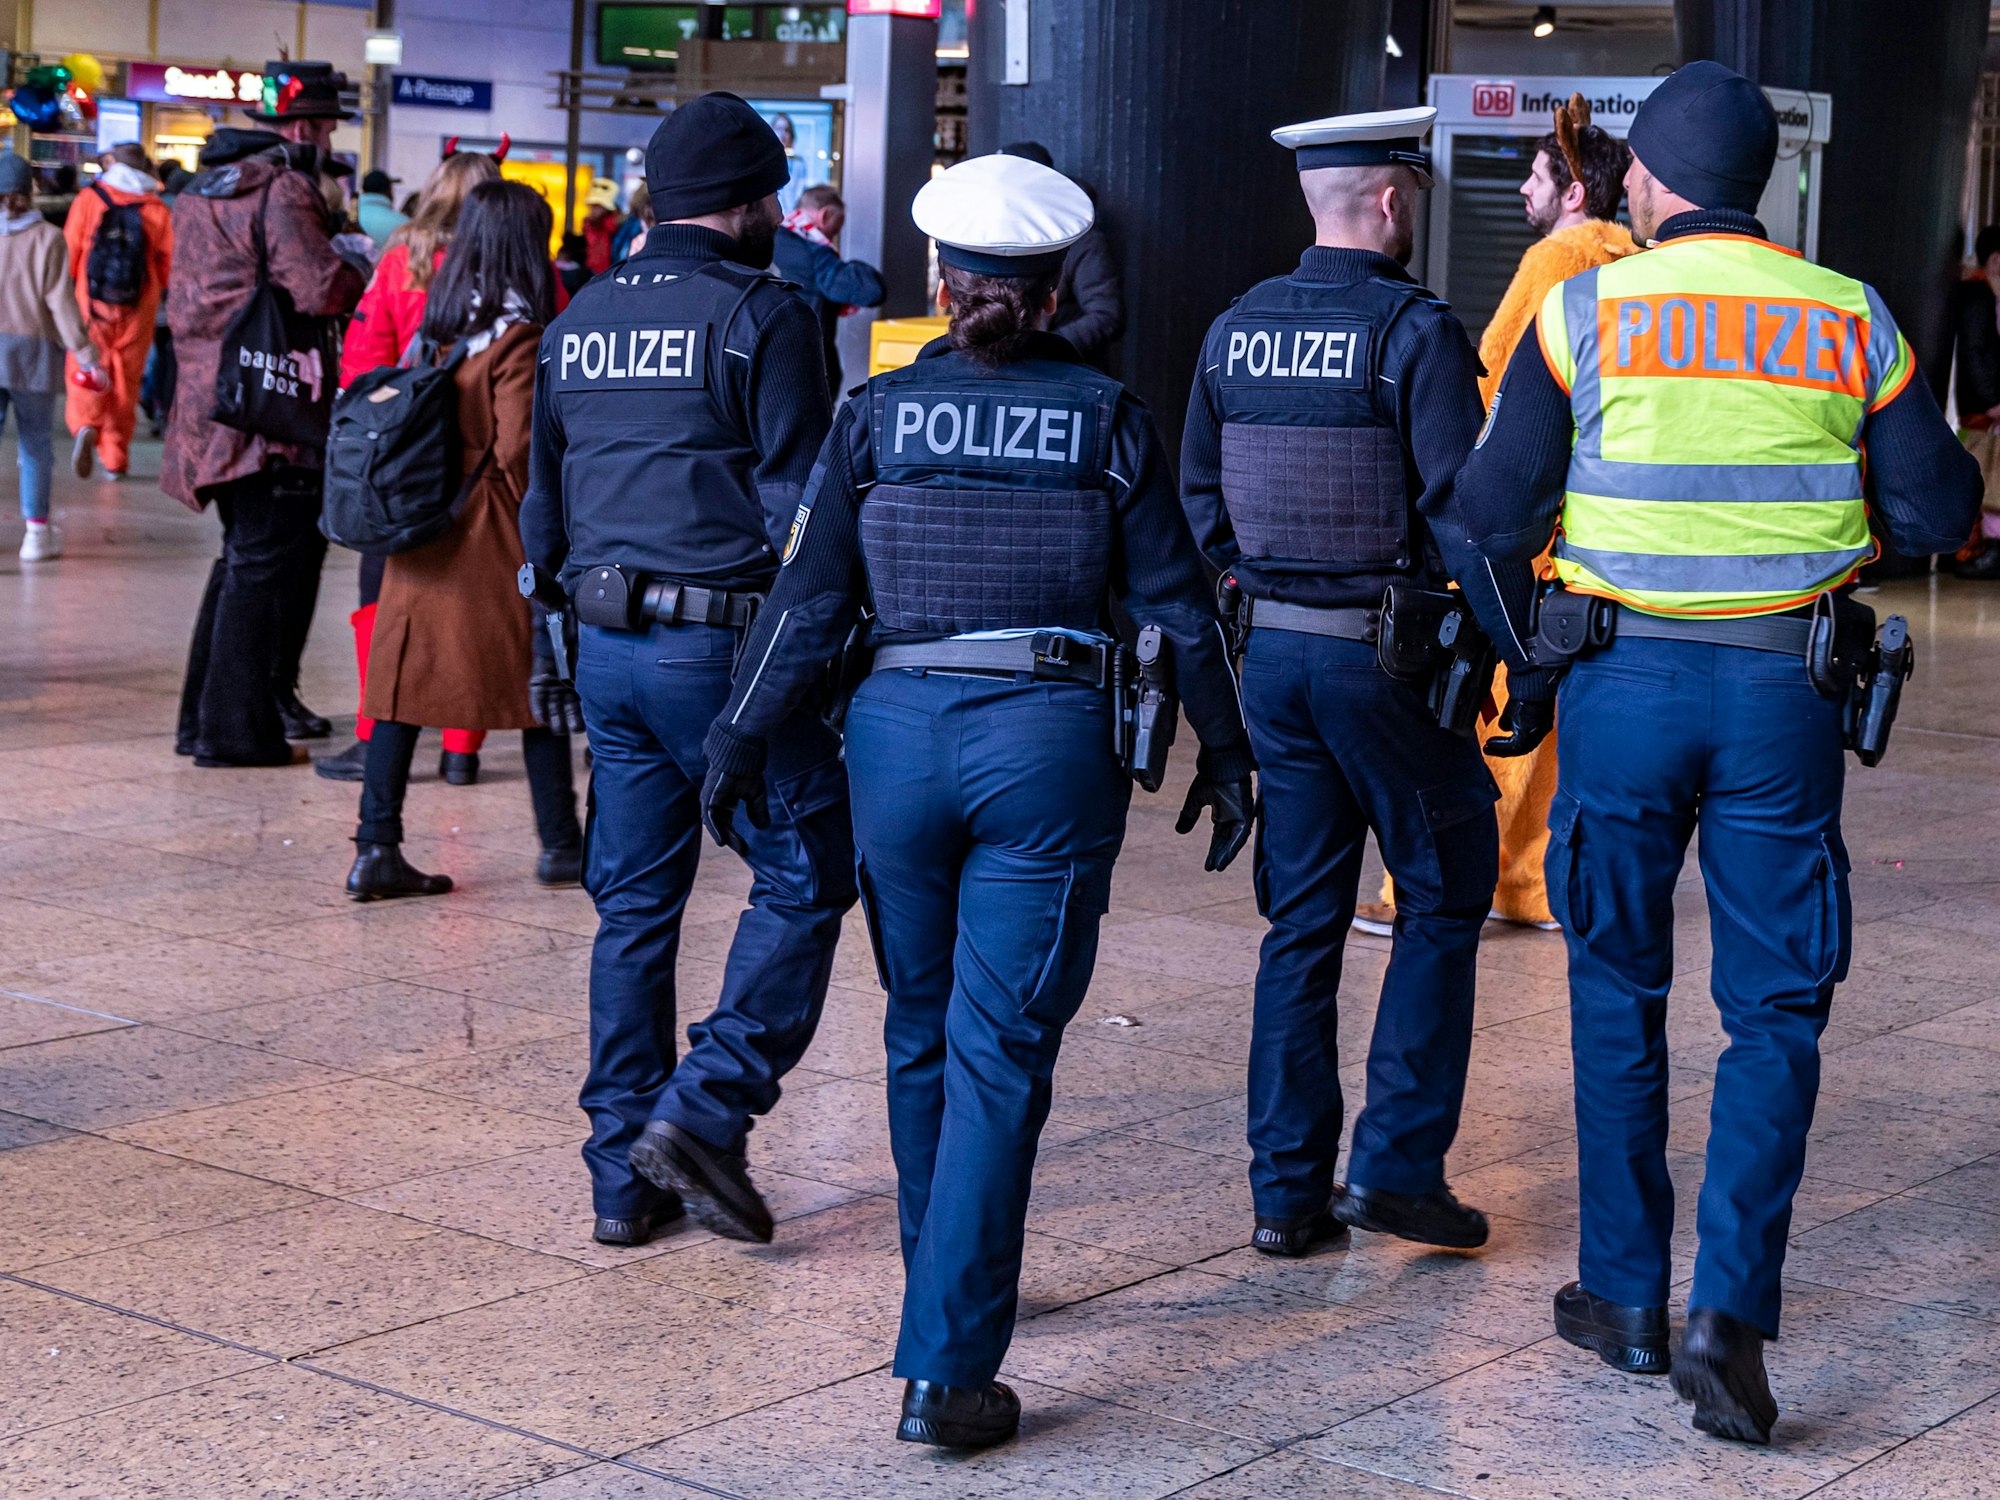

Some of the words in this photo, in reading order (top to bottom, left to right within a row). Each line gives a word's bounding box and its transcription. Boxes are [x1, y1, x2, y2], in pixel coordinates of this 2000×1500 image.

[398, 78, 475, 106] A-Passage
[1478, 88, 1510, 113] DB
[561, 329, 696, 381] POLIZEI
[1226, 330, 1358, 379] POLIZEI
[1618, 298, 1857, 386] POLIZEI
[262, 368, 299, 398] box
[894, 401, 1083, 464] POLIZEI
